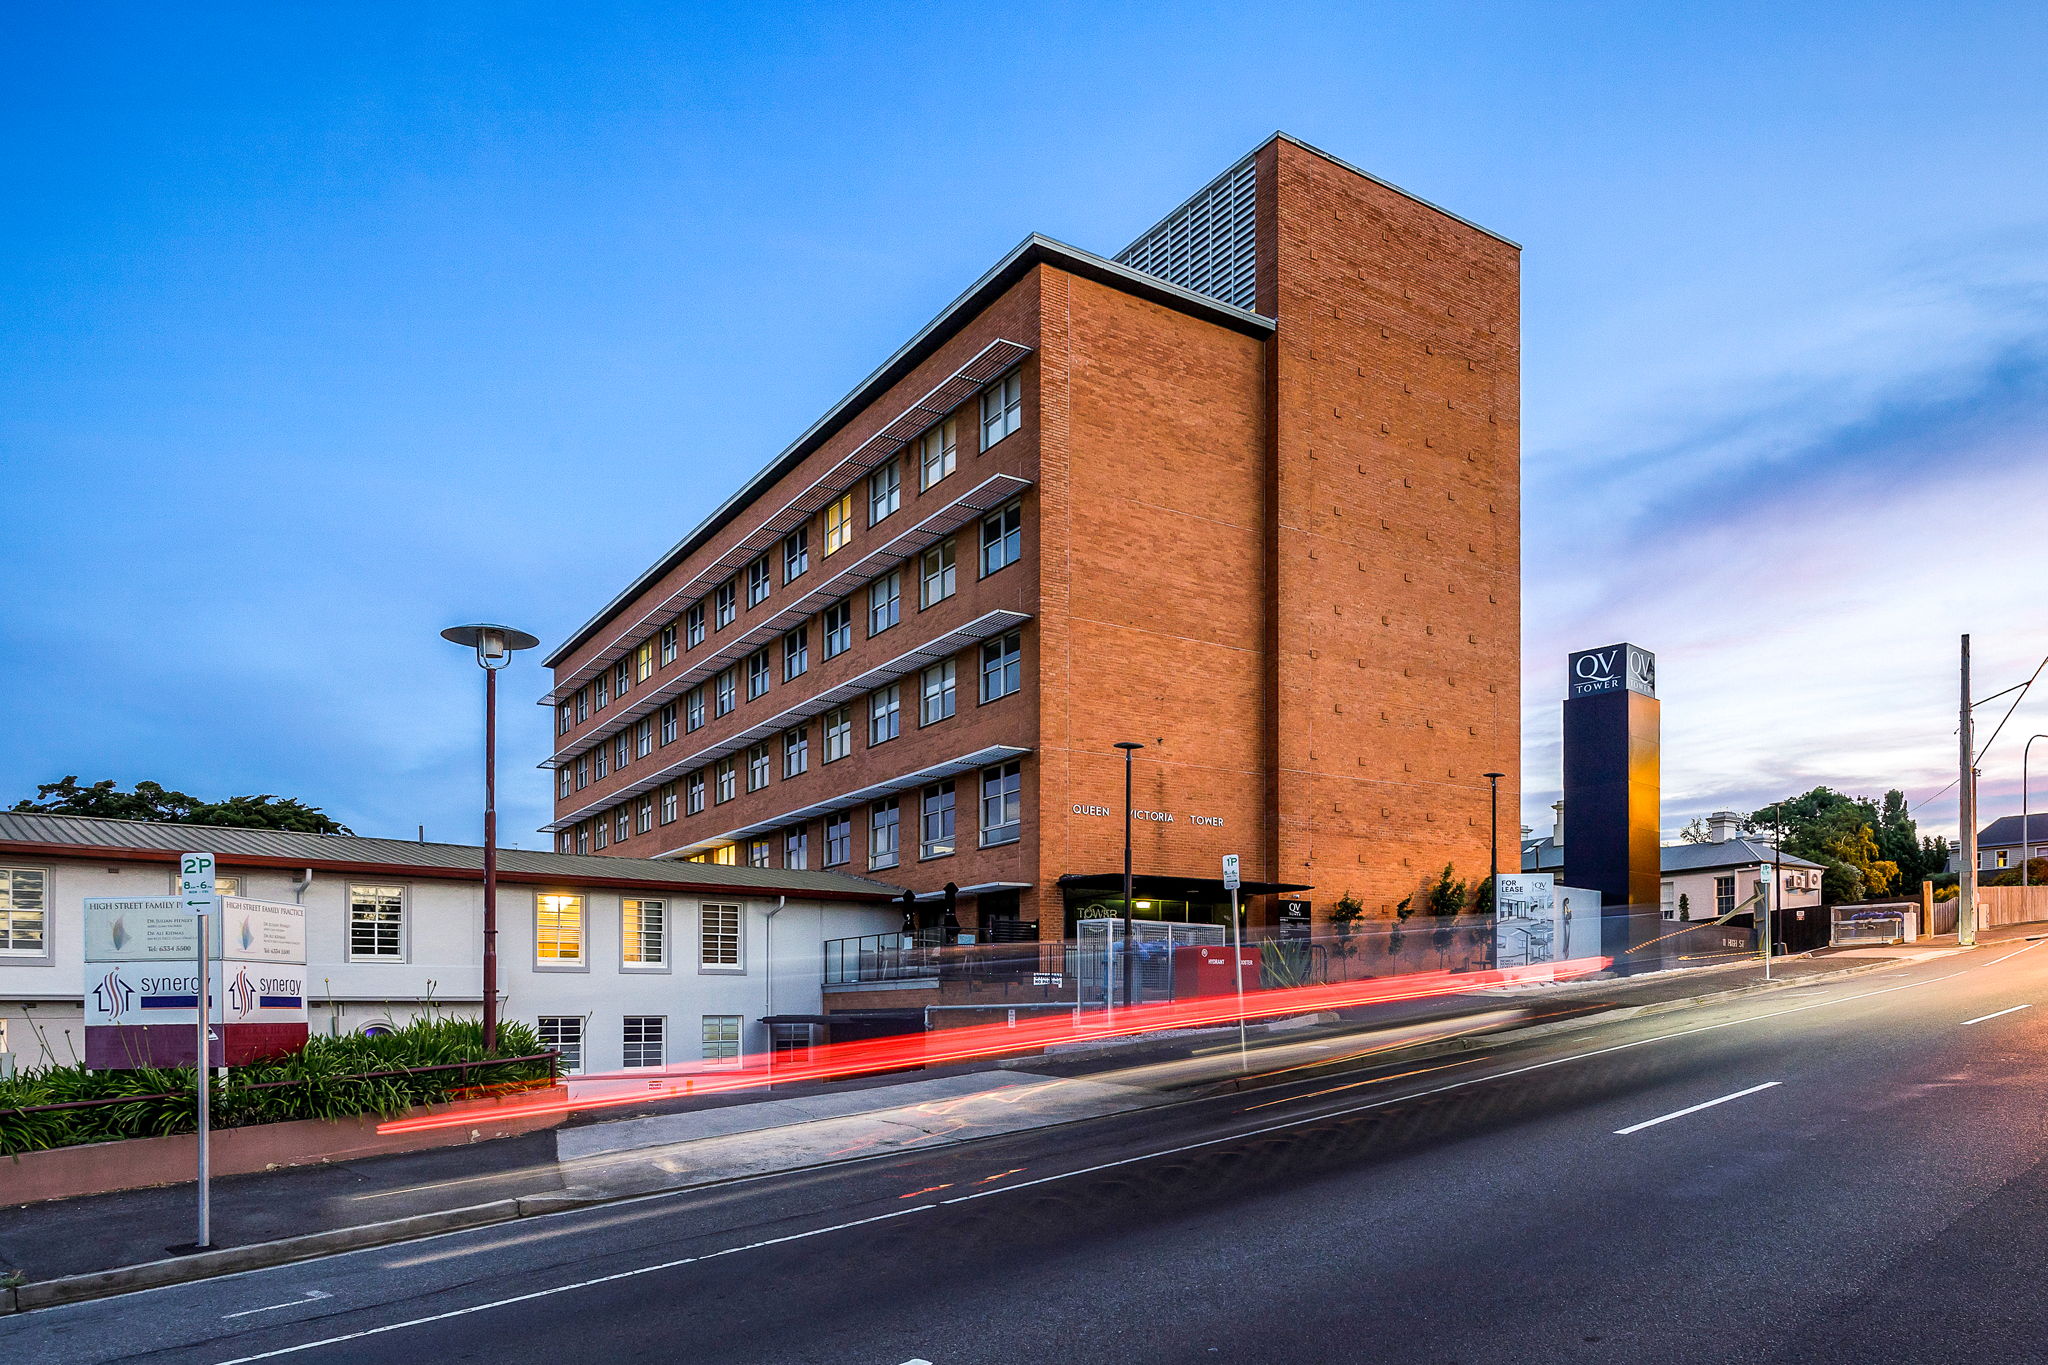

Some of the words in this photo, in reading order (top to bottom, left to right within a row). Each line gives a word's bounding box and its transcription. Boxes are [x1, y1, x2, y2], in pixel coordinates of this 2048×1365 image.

[1576, 650, 1618, 682] QV
[1630, 651, 1651, 684] QV
[1576, 680, 1618, 694] TOWER
[1072, 804, 1110, 817] QUEEN
[1190, 815, 1224, 827] TOWER
[184, 858, 211, 873] 2P
[1227, 858, 1237, 866] 1P
[89, 902, 112, 910] HIGH
[115, 902, 143, 910] STREET
[145, 901, 174, 909] FAMILY
[226, 901, 242, 910] HIGH
[243, 903, 261, 912] STREET
[262, 905, 280, 914] FAMILY
[280, 908, 304, 917] PRACTICE
[1289, 903, 1301, 913] QV
[141, 976, 211, 995] synerg
[260, 977, 302, 996] synergy
